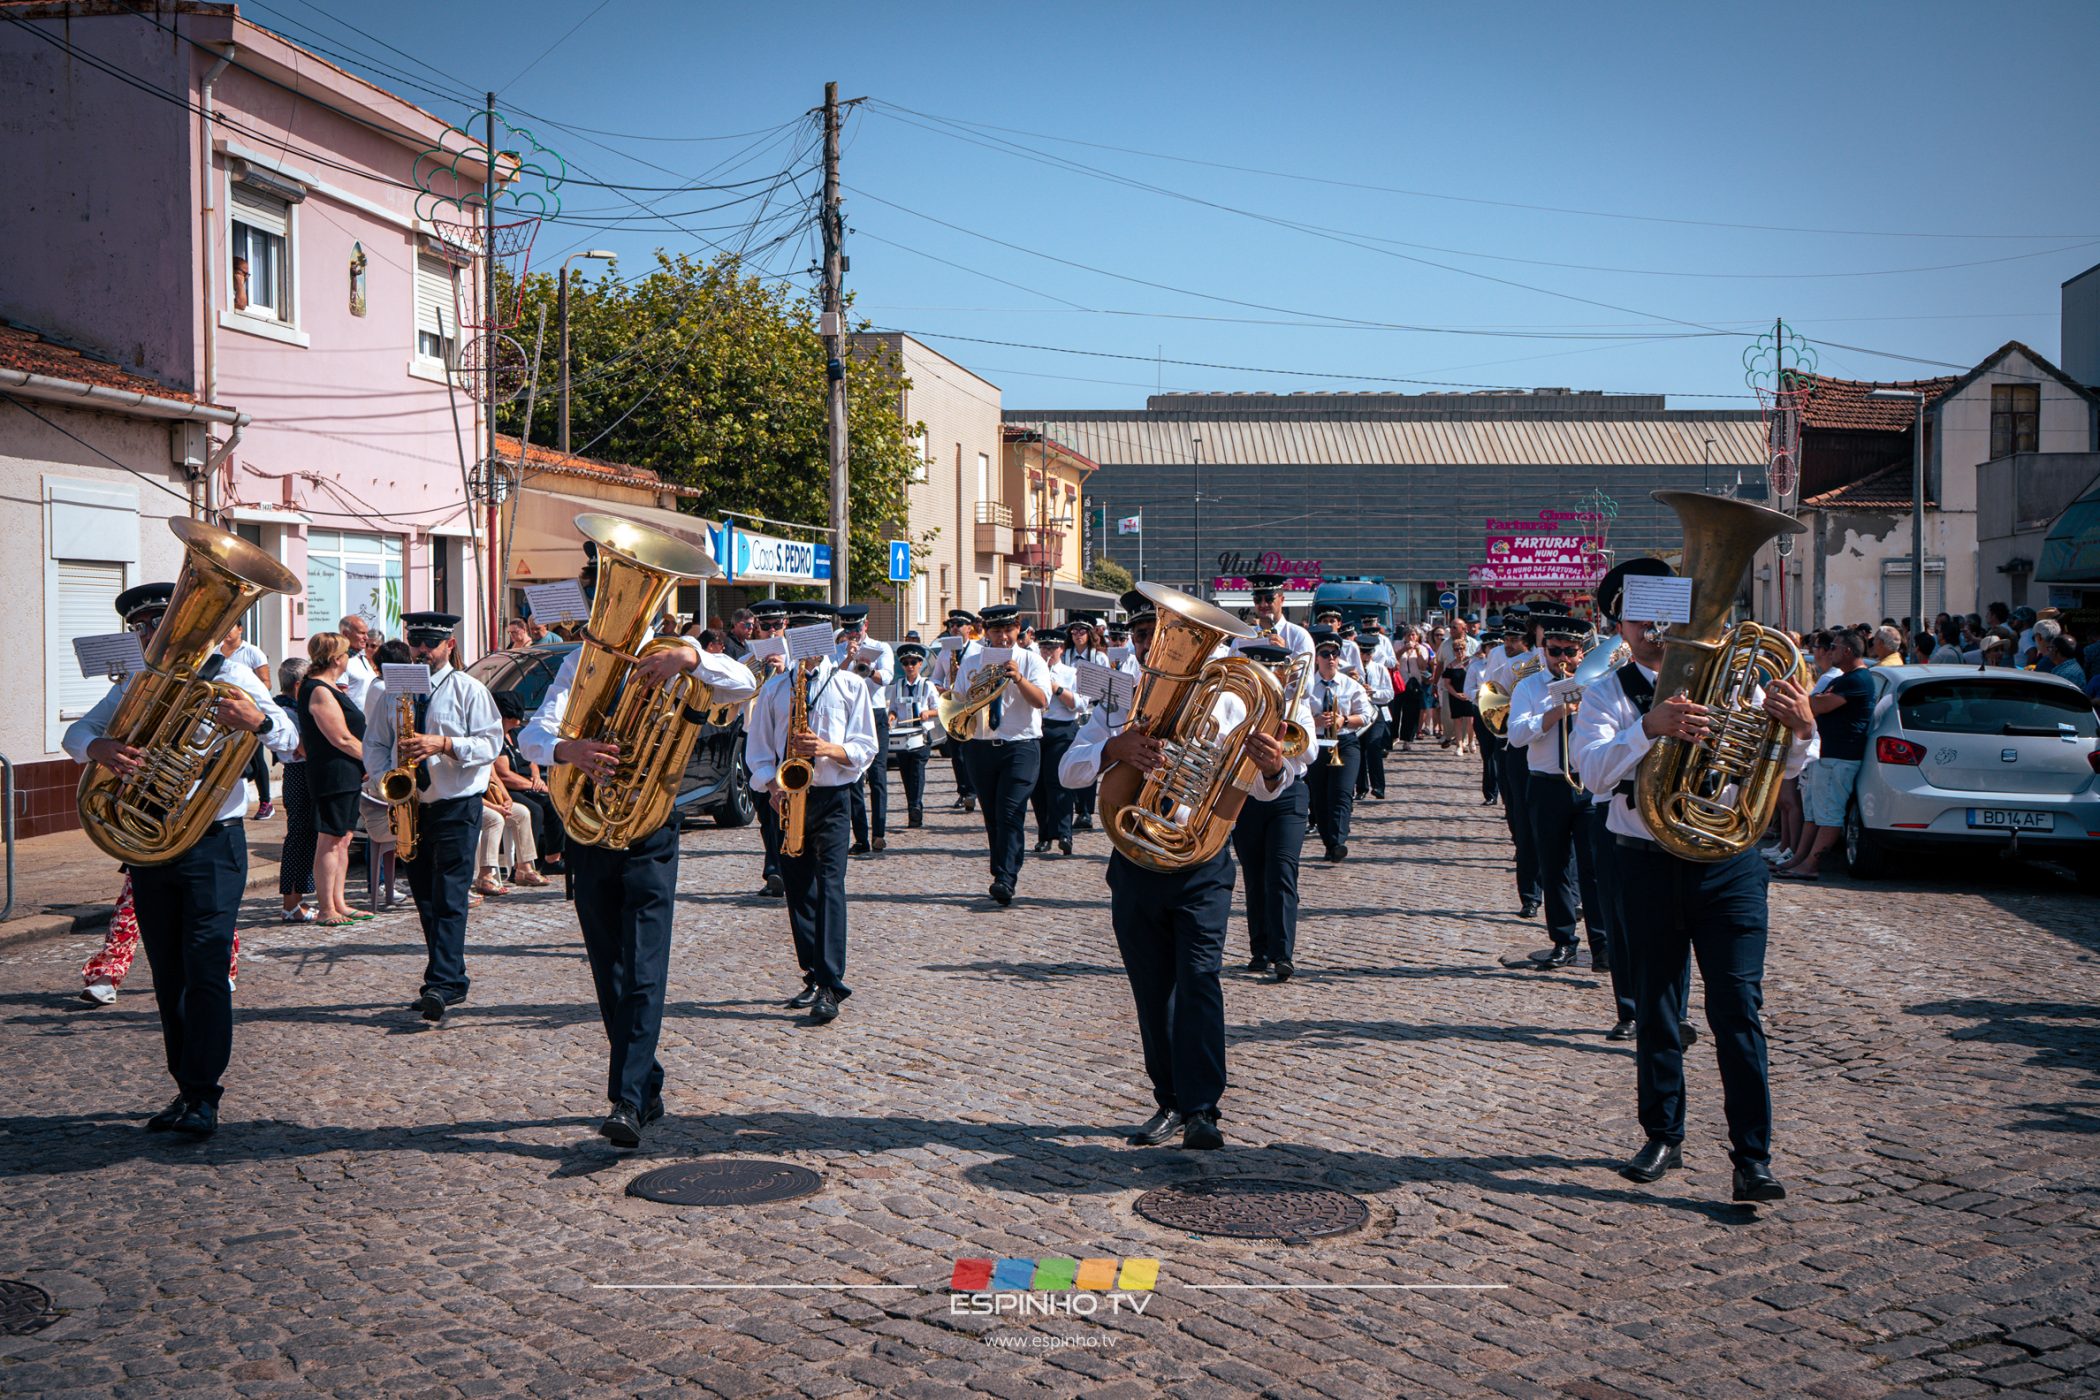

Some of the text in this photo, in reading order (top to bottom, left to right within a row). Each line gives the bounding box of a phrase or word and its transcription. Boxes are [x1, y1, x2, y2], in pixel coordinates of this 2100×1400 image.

[1486, 518, 1559, 530] Farturas
[1514, 537, 1579, 549] FARTURAS
[776, 543, 784, 572] S.
[785, 544, 812, 574] PEDRO
[1534, 549, 1559, 558] NUNO
[1512, 566, 1533, 574] NUNO
[1533, 565, 1547, 573] DAS
[1547, 566, 1582, 575] FARTURAS
